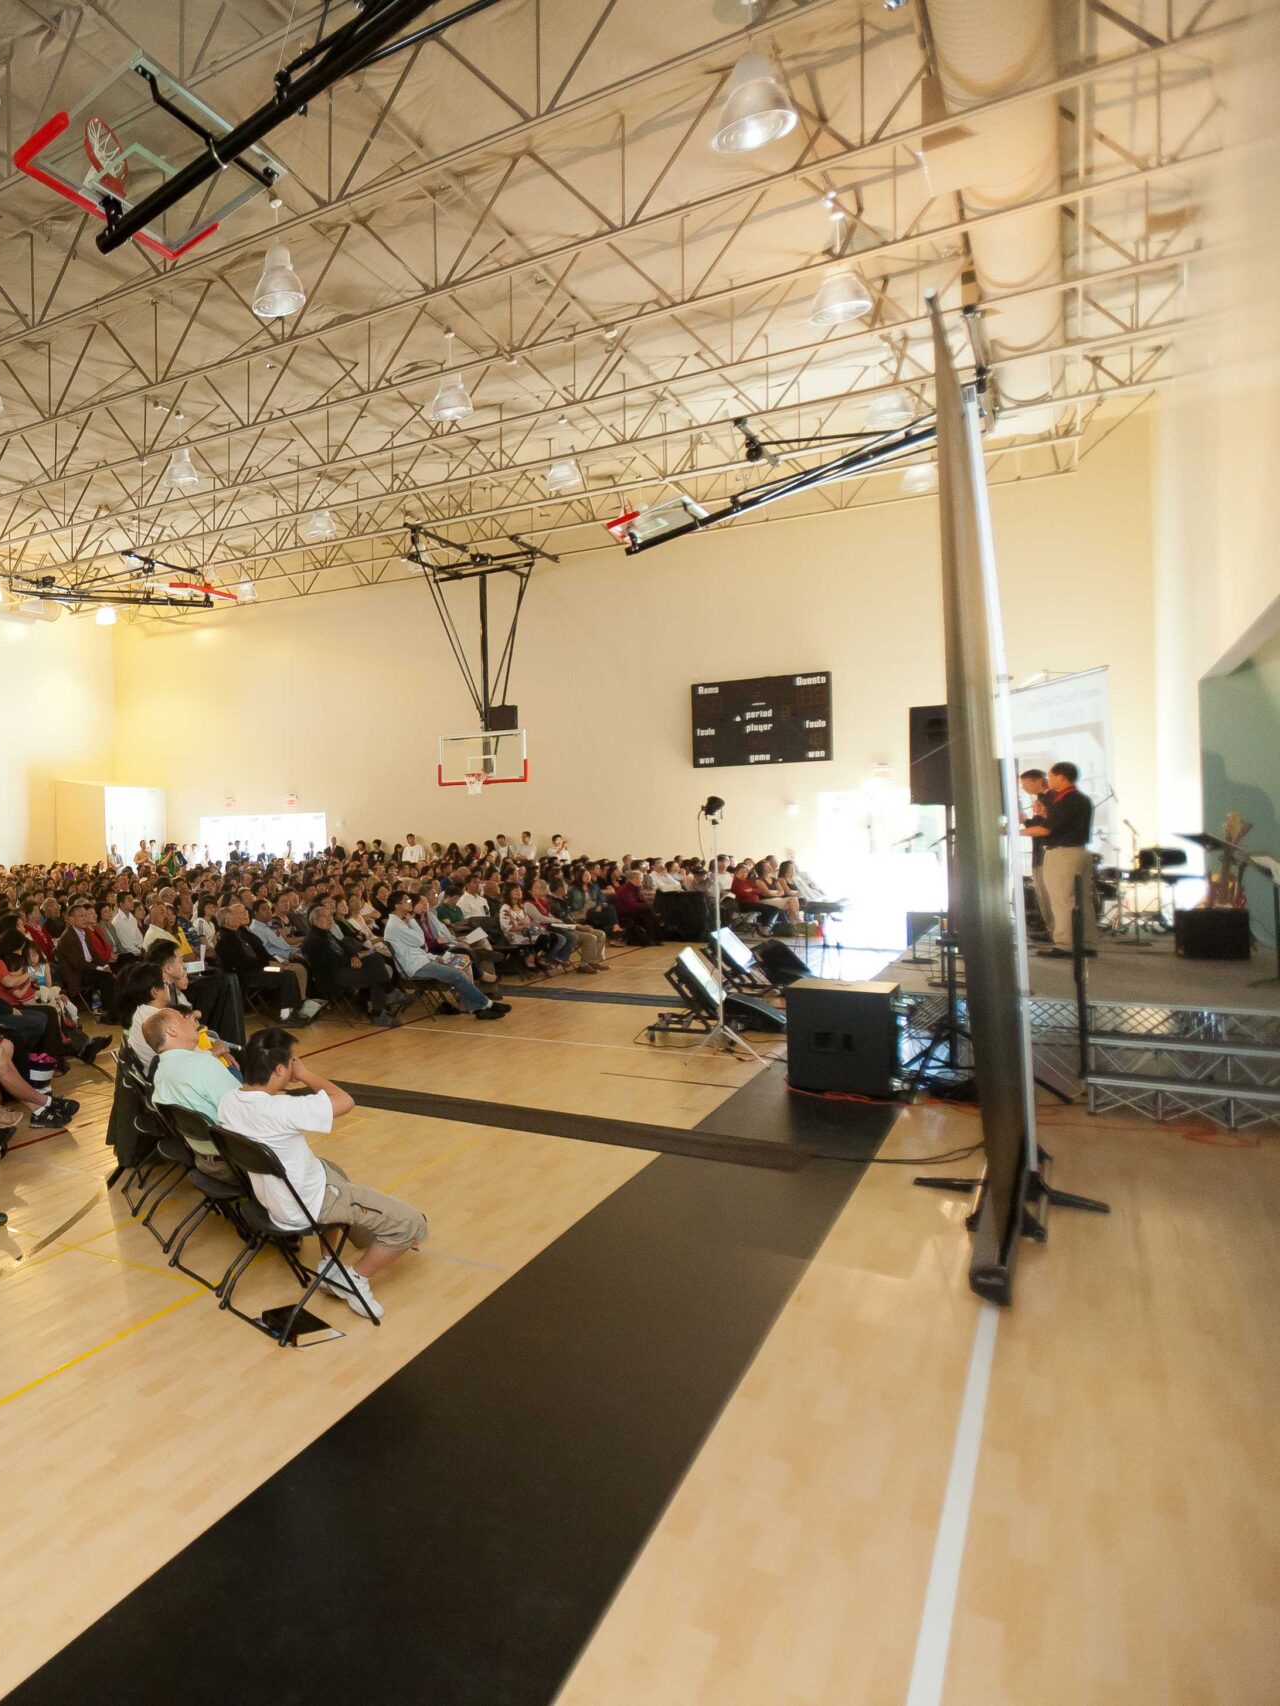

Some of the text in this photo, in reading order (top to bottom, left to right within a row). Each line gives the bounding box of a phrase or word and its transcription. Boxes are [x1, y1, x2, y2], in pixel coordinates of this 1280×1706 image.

[796, 676, 826, 686] Guests
[746, 709, 772, 720] period
[746, 723, 773, 733] player
[806, 719, 826, 728] fouls
[697, 728, 715, 736] fouls
[749, 754, 770, 763] game
[808, 750, 825, 758] won
